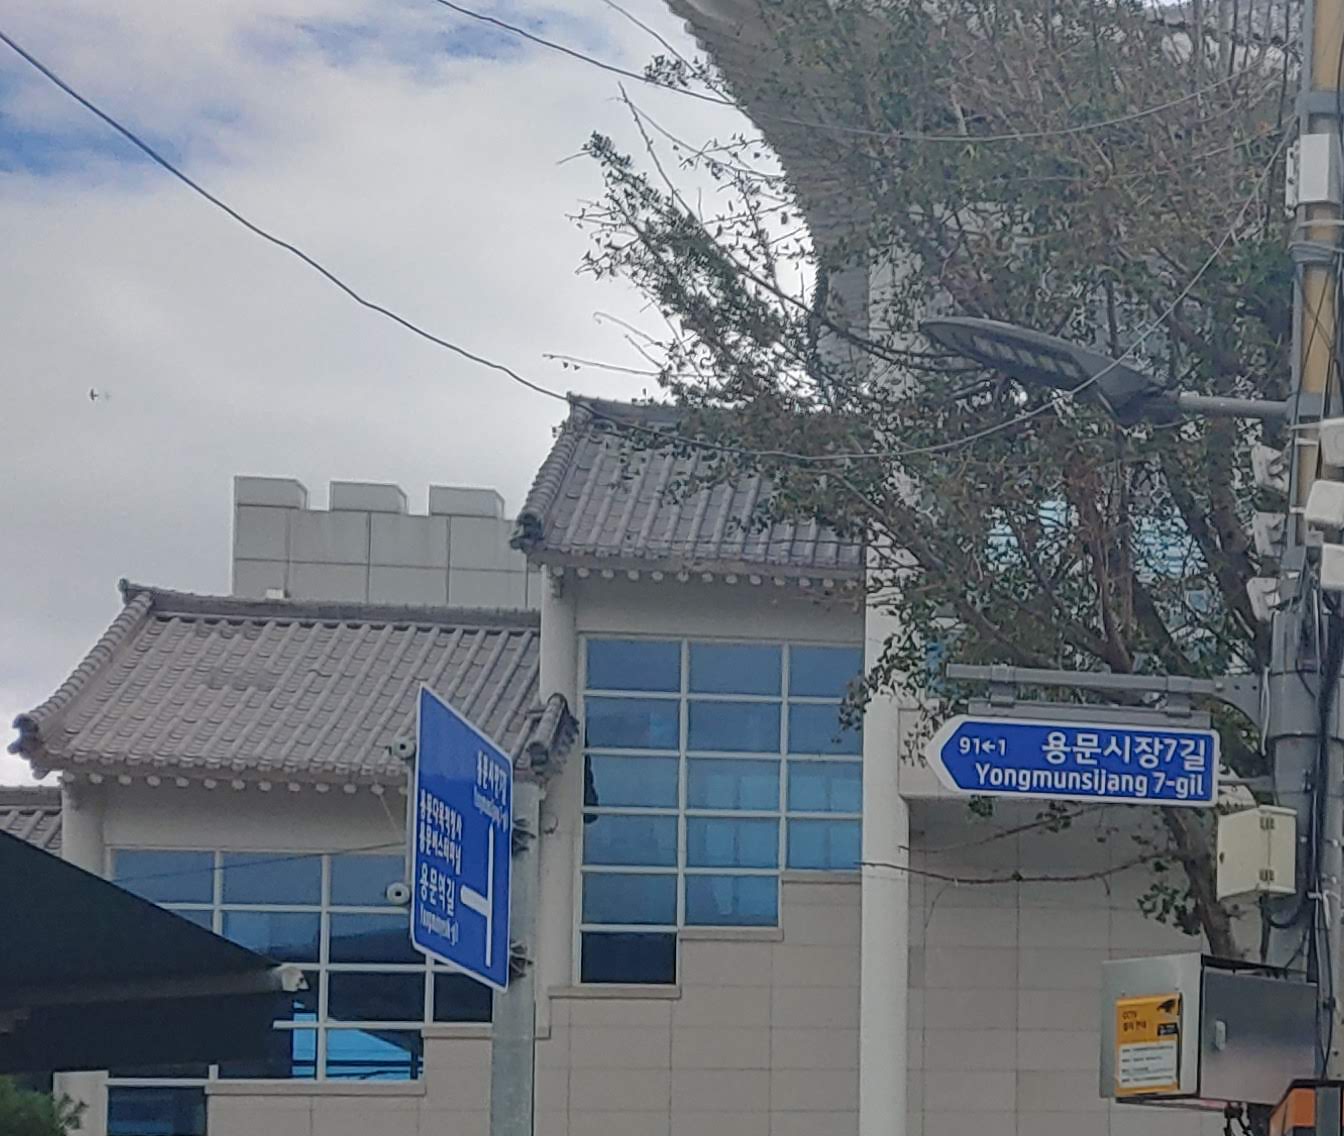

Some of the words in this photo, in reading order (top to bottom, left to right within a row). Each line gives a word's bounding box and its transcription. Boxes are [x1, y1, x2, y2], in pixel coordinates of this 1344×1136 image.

[1042, 731, 1206, 771] 용문시장7길
[975, 762, 1149, 797] Yongmunsijang
[1152, 771, 1204, 799] 7-gil
[419, 862, 455, 917] 용문역길
